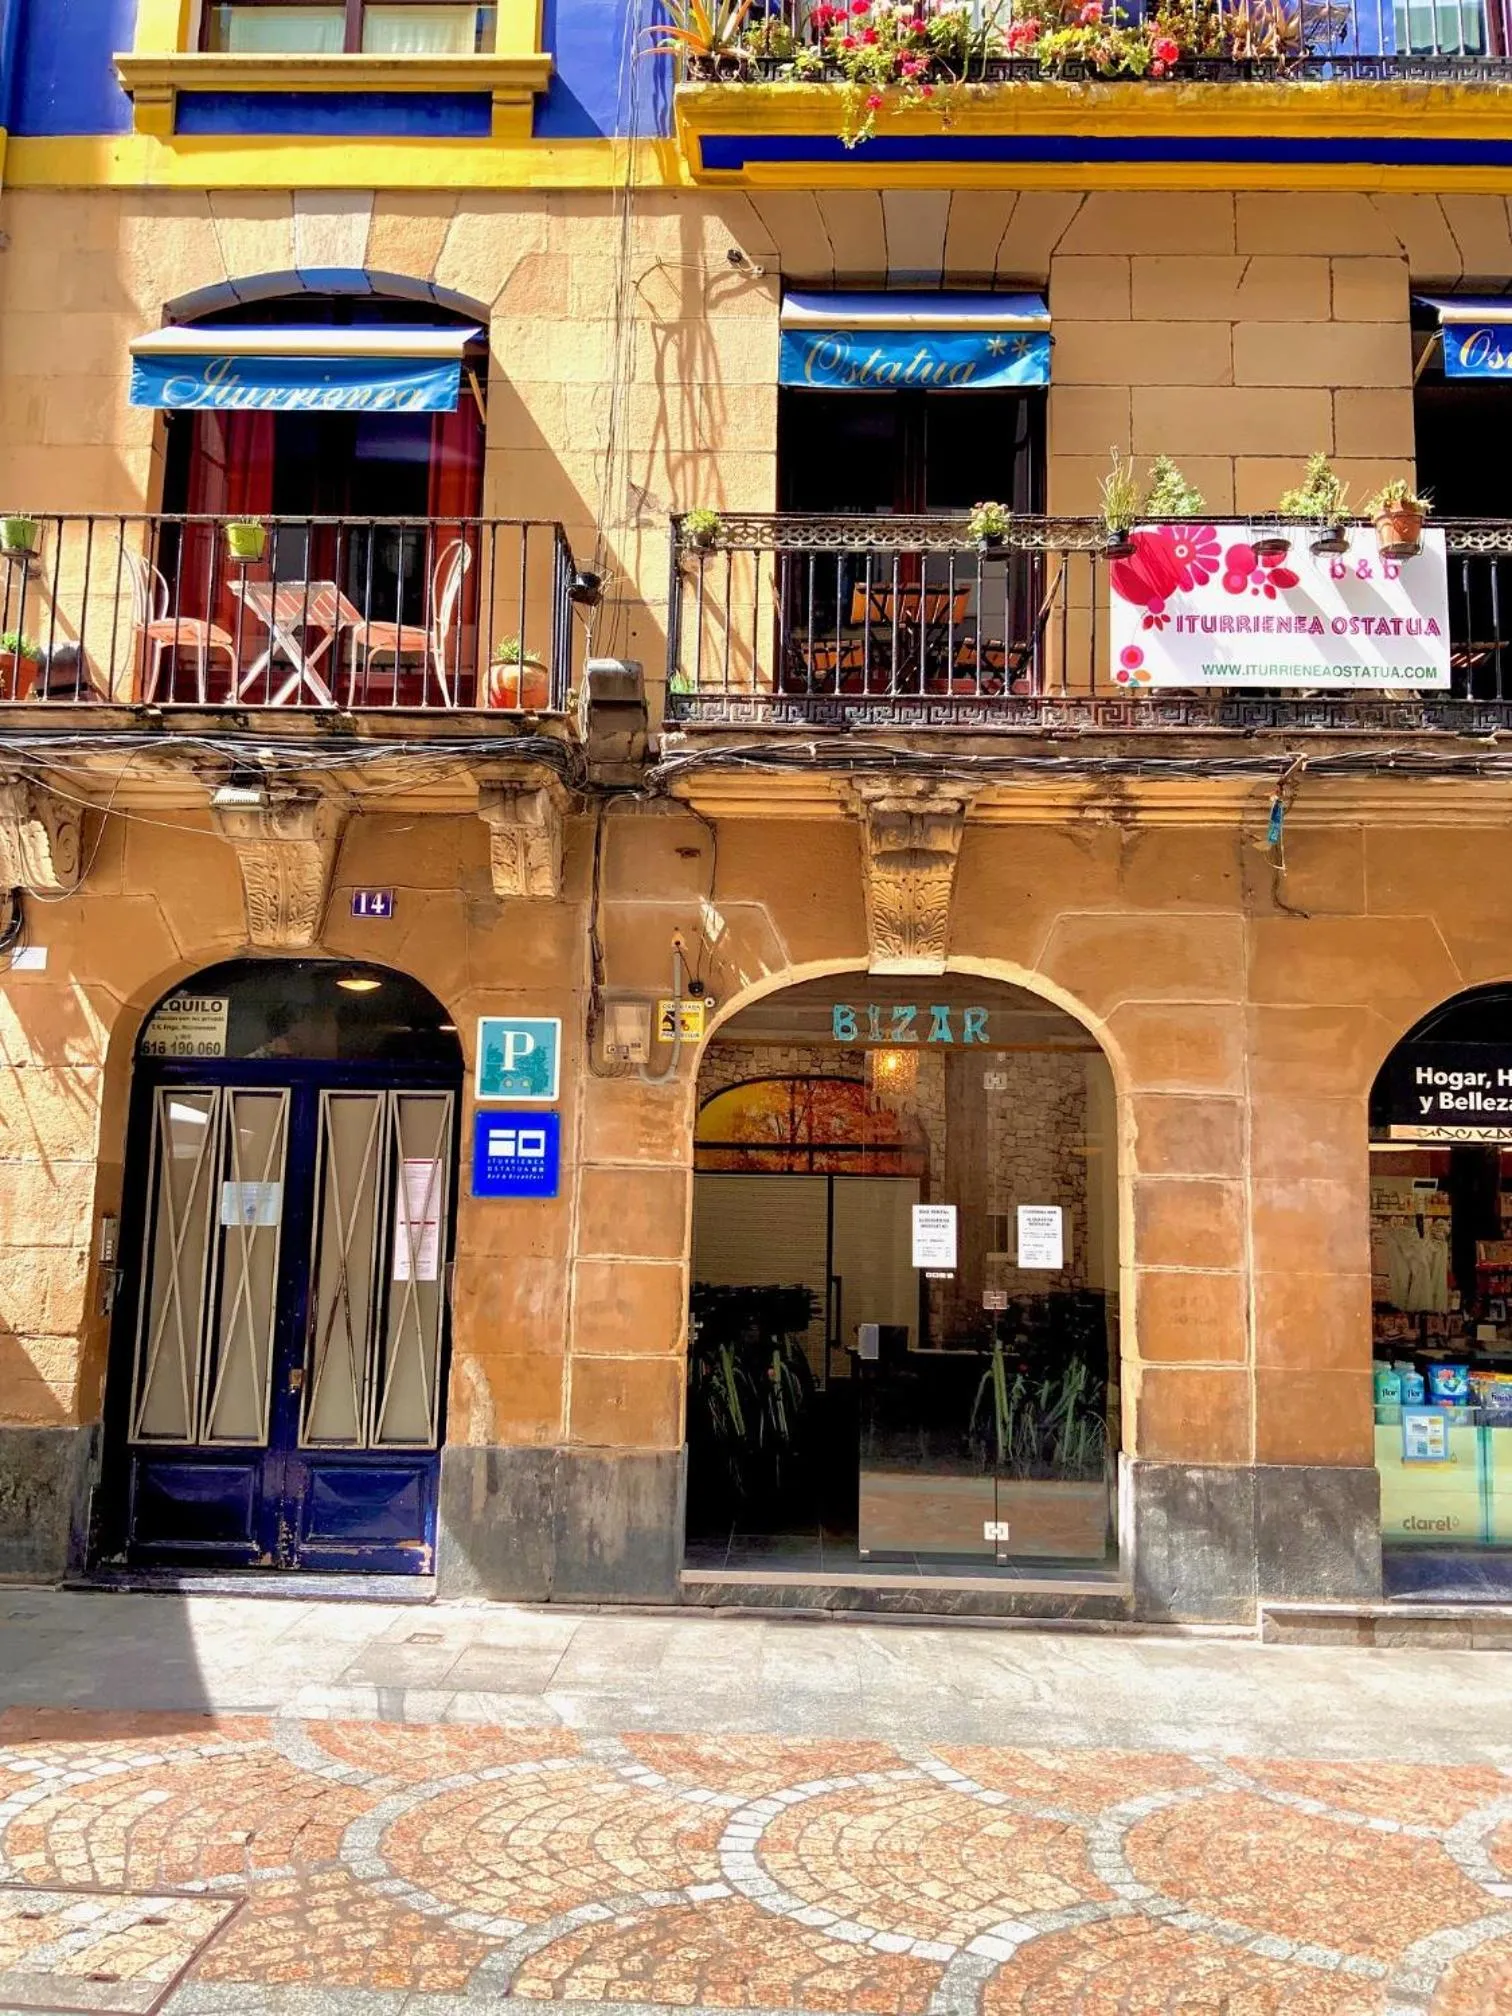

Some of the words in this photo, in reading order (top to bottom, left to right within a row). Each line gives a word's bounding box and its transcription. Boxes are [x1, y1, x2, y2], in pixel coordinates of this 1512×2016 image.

[804, 331, 977, 385] Ostatua
[1329, 556, 1346, 580] b
[1355, 558, 1374, 580] &
[1382, 556, 1399, 580] b
[1176, 615, 1325, 635] ITURRIENEA
[1331, 616, 1442, 636] OSTATUA
[1201, 664, 1438, 679] WWW.ITURRIENEAOSTATUA.COM
[360, 891, 385, 914] 14
[832, 1003, 990, 1044] BIZAR
[197, 1041, 221, 1056] 060
[501, 1030, 535, 1071] P
[1416, 1066, 1492, 1091] Hogar,
[1419, 1096, 1434, 1115] y
[1382, 1388, 1397, 1398] flor
[1402, 1516, 1452, 1531] clarel
